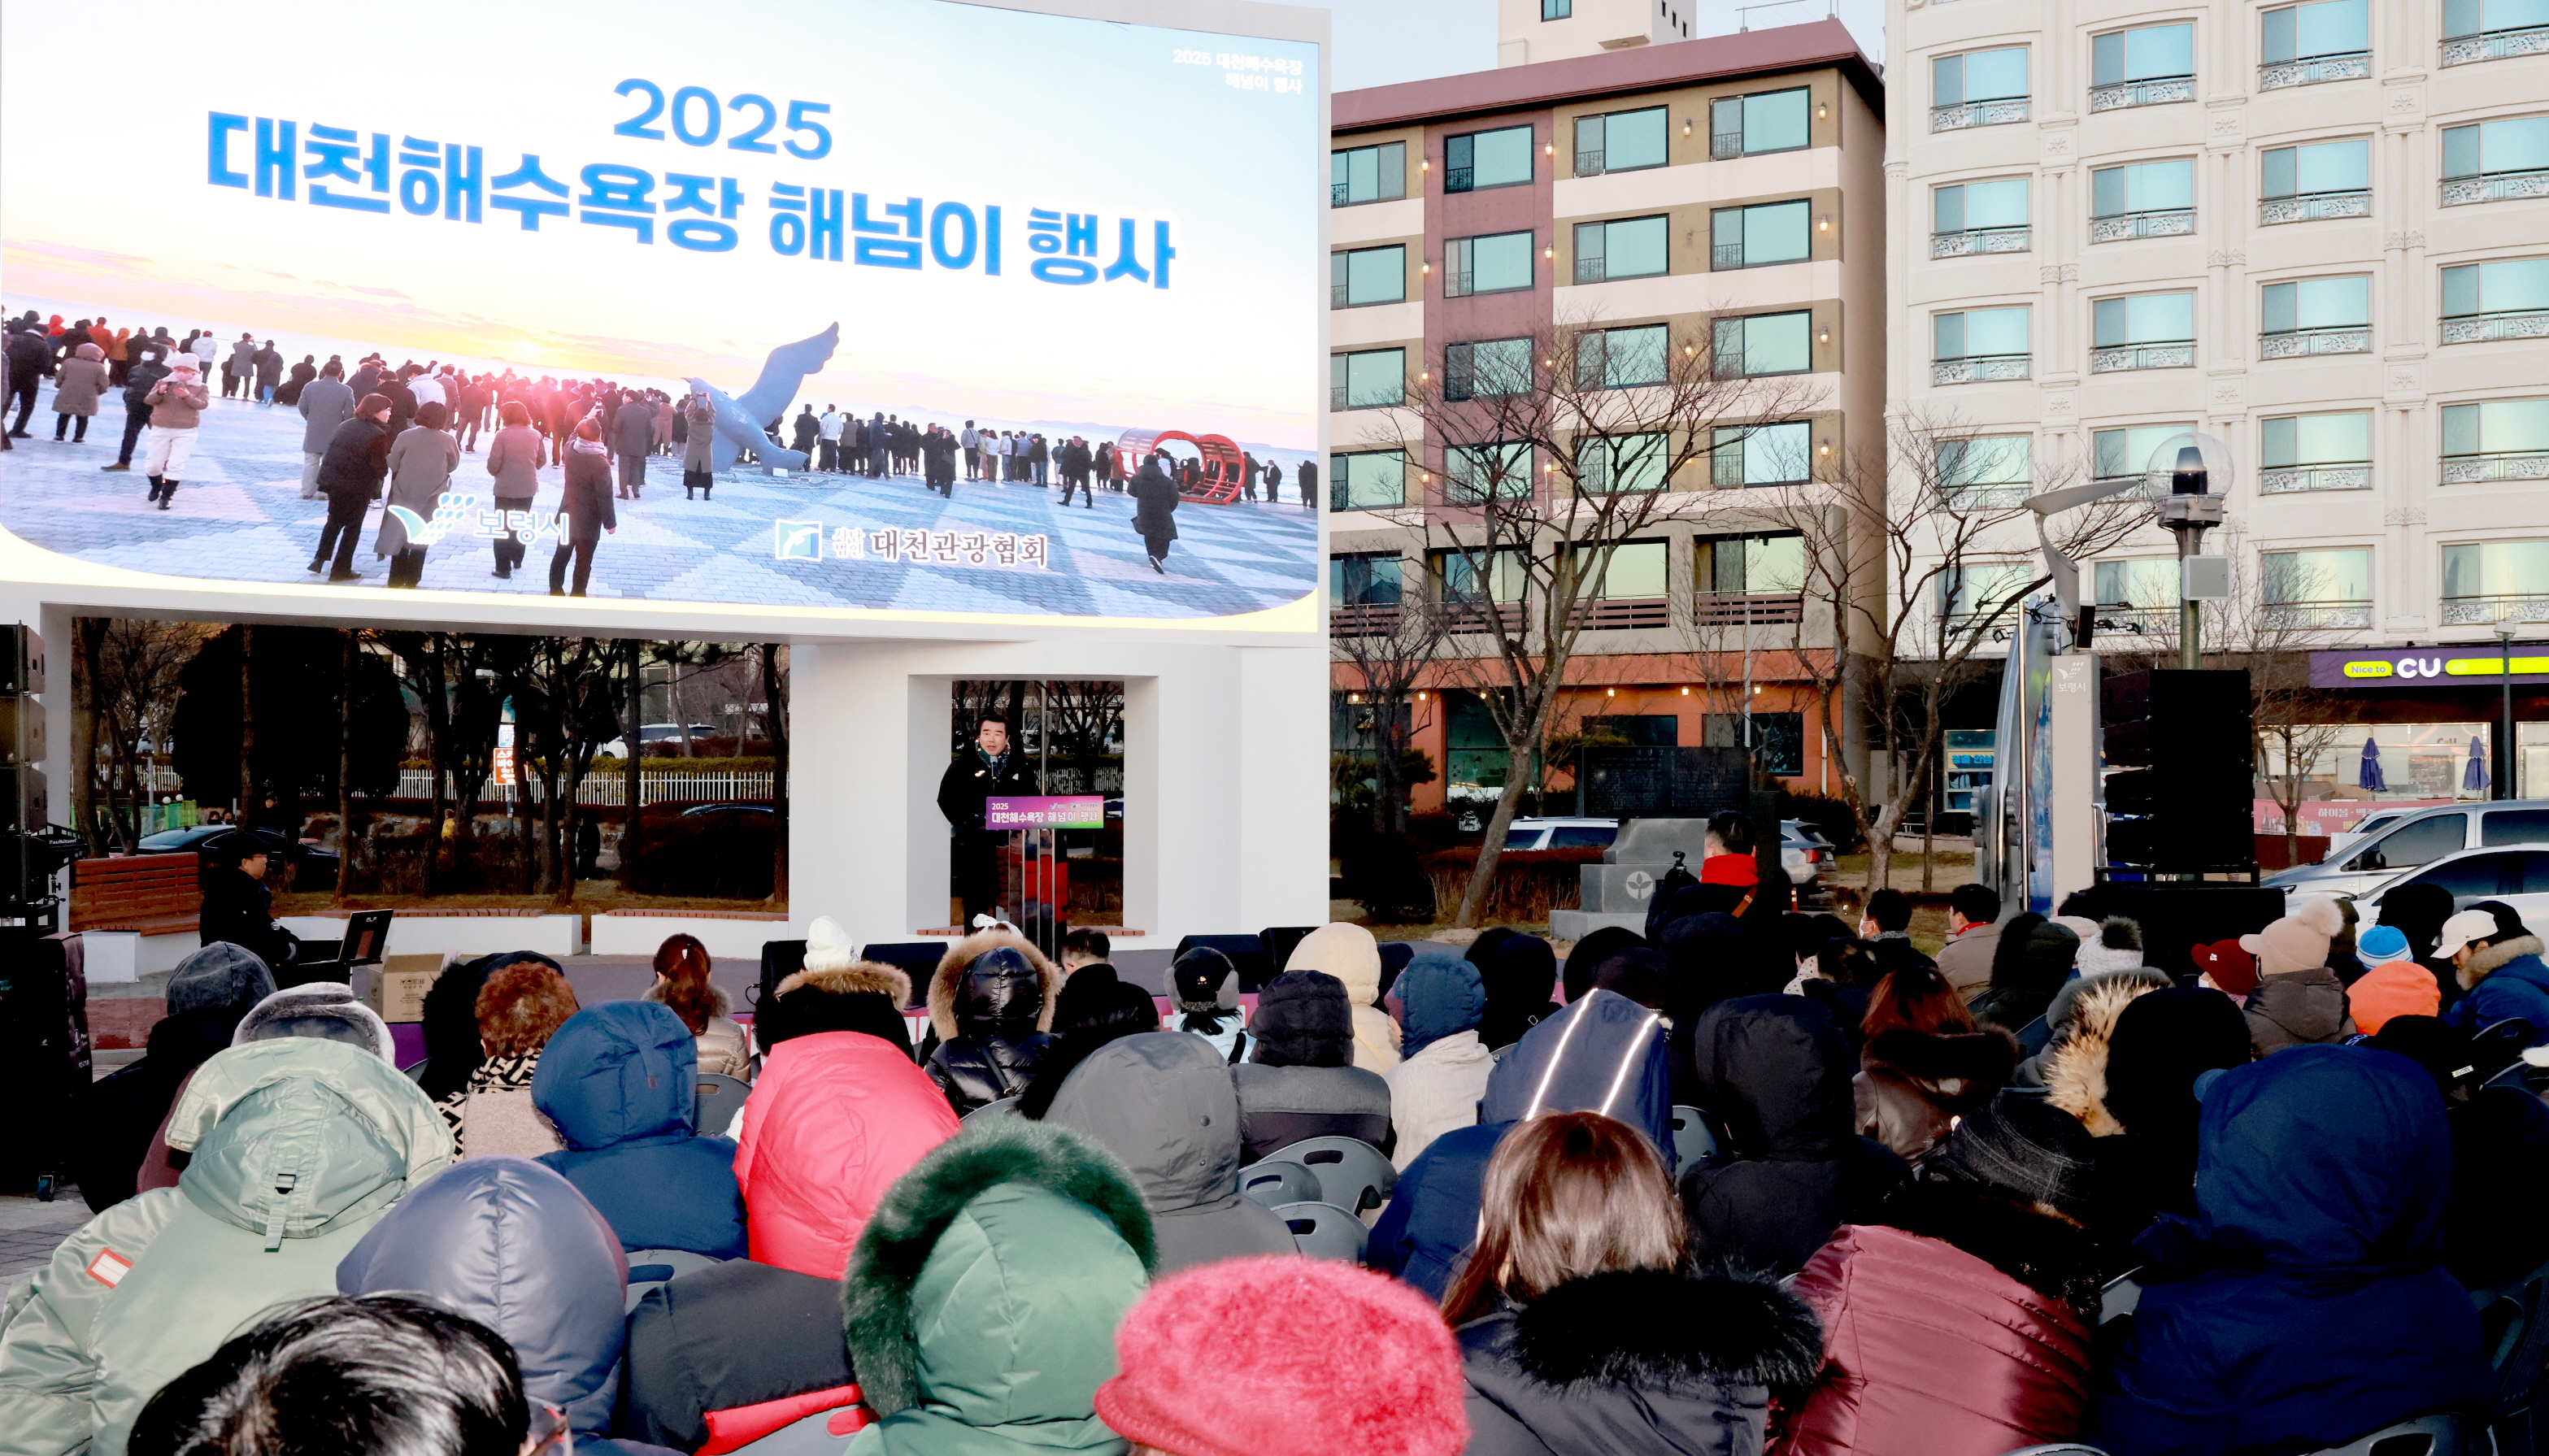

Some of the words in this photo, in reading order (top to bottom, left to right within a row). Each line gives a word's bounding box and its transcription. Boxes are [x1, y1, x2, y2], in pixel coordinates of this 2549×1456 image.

[1173, 49, 1211, 66] 2025
[1216, 53, 1303, 76] 대천해수욕장
[1225, 72, 1268, 91] 해넘이
[1273, 77, 1303, 94] 행사
[614, 78, 833, 160] 2025
[207, 110, 745, 253] 대천해수욕장
[768, 180, 1001, 277] 해넘이
[1027, 206, 1177, 290] 행사
[473, 509, 569, 545] 보령시
[872, 528, 1049, 567] 대천관광협회
[2396, 657, 2441, 679] CU
[2058, 682, 2086, 693] 보령시
[1973, 754, 1993, 764] 안심
[991, 802, 1009, 811] 2025
[991, 811, 1045, 824] 대천해수욕장
[1047, 811, 1076, 823] 해넘이
[1080, 811, 1098, 823] 행사
[2318, 807, 2349, 818] 하이볼
